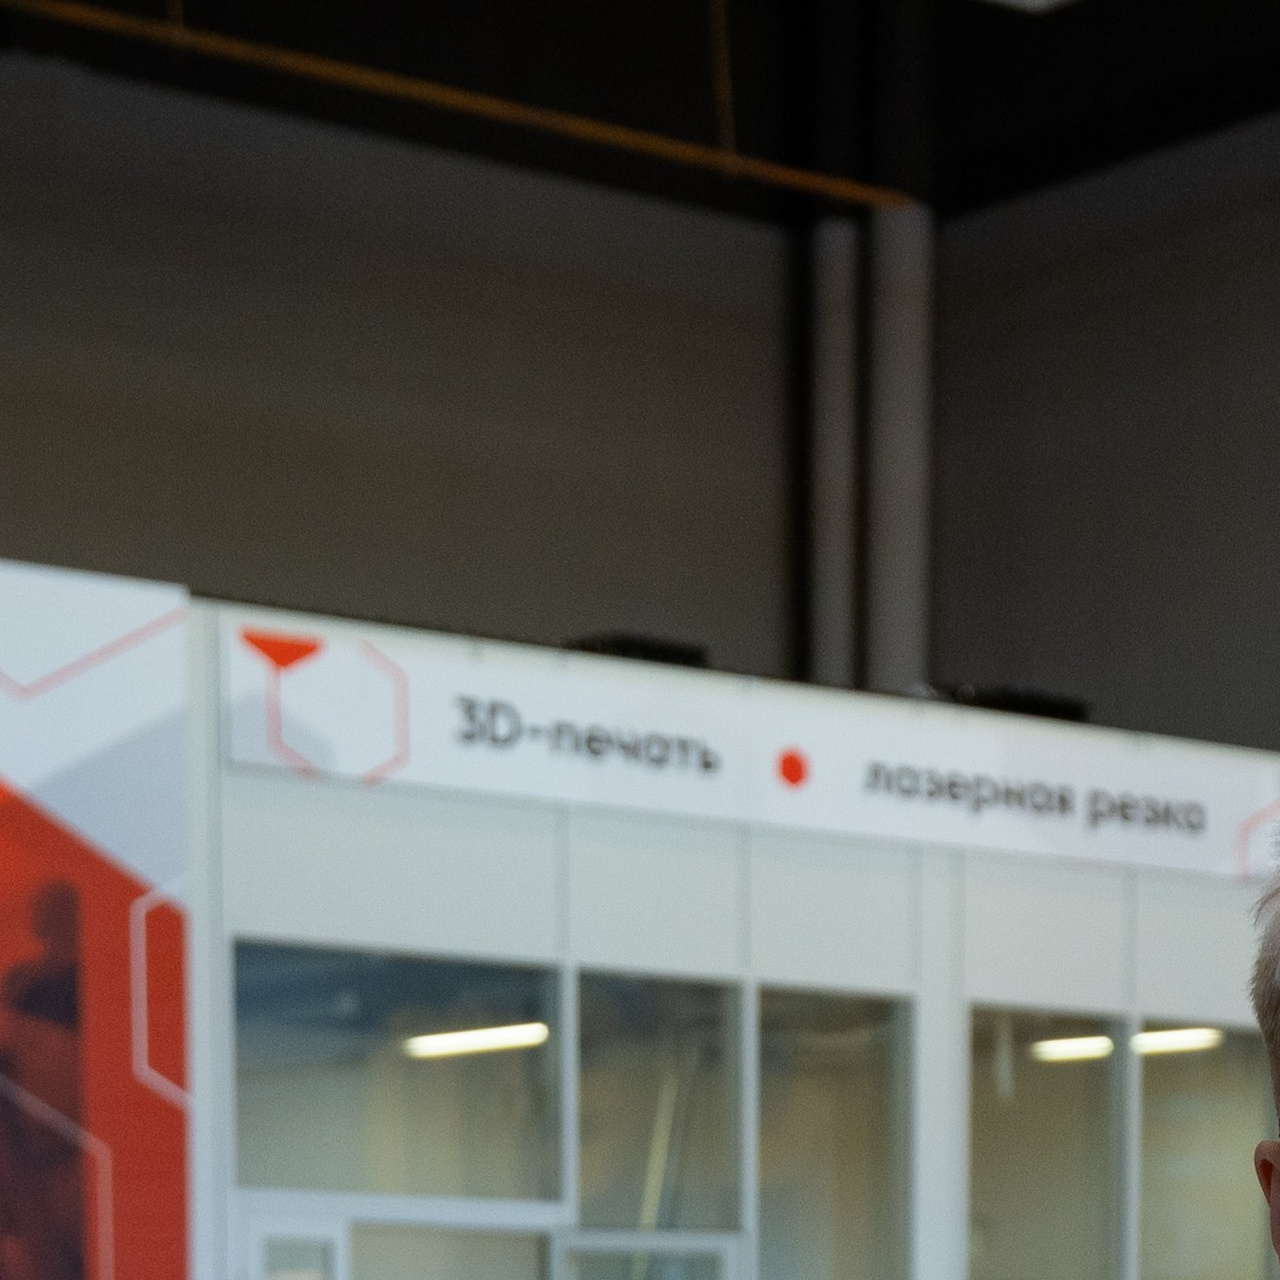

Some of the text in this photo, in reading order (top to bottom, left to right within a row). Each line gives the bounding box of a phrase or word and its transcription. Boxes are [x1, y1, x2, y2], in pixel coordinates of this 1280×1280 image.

[457, 698, 719, 776] 3D-печать
[866, 761, 1205, 834] лазерная резка
